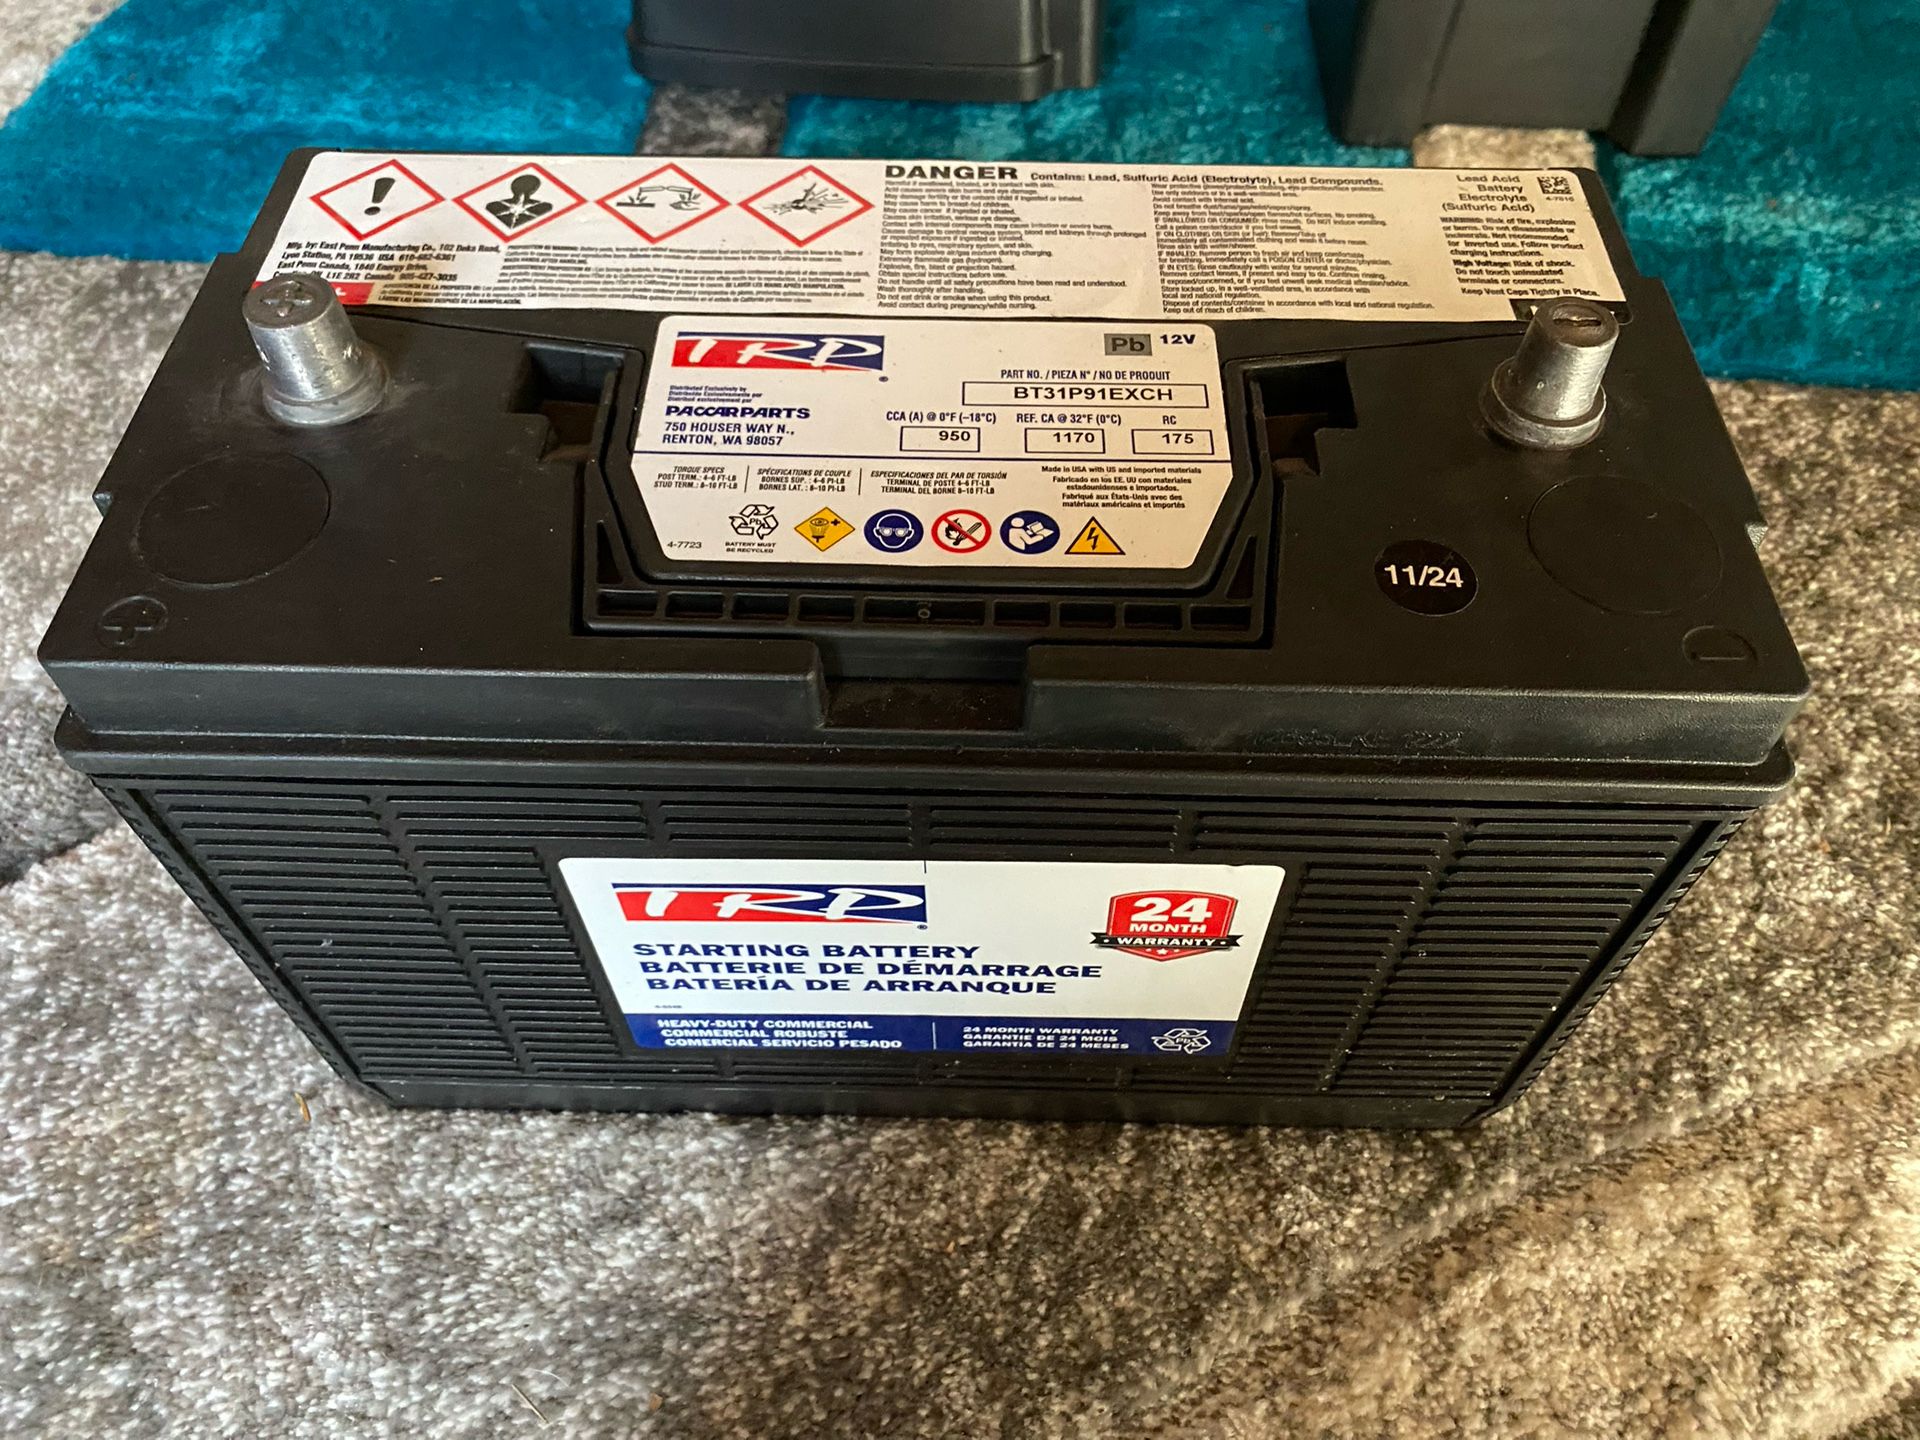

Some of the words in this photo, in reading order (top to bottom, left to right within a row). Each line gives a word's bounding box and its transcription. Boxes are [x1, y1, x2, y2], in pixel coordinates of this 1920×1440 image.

[885, 165, 1017, 180] DANGER
[1088, 173, 1119, 181] Lead,
[1171, 175, 1197, 184] Acid
[1201, 175, 1275, 184] (Electrolyte),
[1278, 176, 1306, 184] Lead
[1309, 177, 1382, 185] Compounds.
[1477, 184, 1523, 192] Battery
[1458, 193, 1527, 201] Electrolyte
[1442, 202, 1496, 211] (Sulfuric
[1501, 203, 1534, 211] Acid)
[1452, 259, 1473, 267] High
[1461, 287, 1482, 295] Keep
[1530, 288, 1560, 296] Tightly
[1572, 288, 1599, 297] Place.
[1111, 337, 1145, 352] Pb
[1160, 334, 1196, 345] 12V
[674, 333, 883, 371] TRP
[1000, 369, 1023, 378] PART
[1026, 369, 1042, 379] NO.
[1051, 369, 1077, 379] PIEZA
[1099, 370, 1112, 379] NO
[1114, 370, 1126, 379] DE
[1129, 370, 1169, 380] PRODUIT
[1014, 386, 1173, 401] BT31P91EXCH
[886, 411, 905, 421] CCA
[908, 411, 923, 423] (A)
[939, 412, 955, 421] 0°F
[1016, 413, 1037, 423] REF.
[1040, 413, 1054, 423] CA
[1070, 413, 1092, 423] 32°F
[1096, 414, 1121, 425] (0°C)
[1162, 415, 1177, 425] RC
[665, 421, 687, 431] 750
[689, 421, 742, 433] HOUSER
[744, 423, 772, 435] WAY
[661, 433, 717, 444] RENTON,
[721, 435, 742, 444] WA
[745, 435, 782, 445] 98057
[938, 430, 971, 442] 950
[1053, 432, 1095, 444] 1170
[1161, 433, 1194, 445] 175
[673, 465, 701, 474] TORQUE
[701, 466, 725, 475] SPECS
[756, 468, 812, 477] SPÉCIFICATIONS
[813, 469, 823, 477] DE
[824, 469, 851, 478] COUPLE
[869, 470, 935, 479] ESPECIFICACIONES
[950, 471, 965, 480] PAR
[965, 472, 975, 480] DE
[976, 472, 1007, 480] TORSIÓN
[1100, 476, 1112, 484] los
[1061, 493, 1093, 501] Fabriqué
[1110, 493, 1148, 501] États-Unis
[667, 541, 702, 550] 4-7723
[1384, 564, 1464, 588] 11/24
[614, 885, 925, 922] TRP
[1130, 896, 1212, 923] 24
[1129, 923, 1207, 934] MONTH
[1116, 937, 1216, 947] WARRANTY
[634, 943, 809, 956] STARTING
[823, 945, 978, 958] BATTERY
[641, 961, 804, 974] BATTERIE
[818, 962, 864, 975] DE
[877, 960, 1103, 978] DÉMARRAGE
[647, 975, 793, 991] BATERÍA
[805, 979, 850, 992] DE
[863, 980, 1057, 995] ARRANQUE
[657, 1019, 757, 1029] HEAVY-DUTY
[763, 1020, 872, 1030] COMMERCIAL
[661, 1029, 769, 1039] COMMERCIAL
[773, 1029, 847, 1039] ROBUSTE
[963, 1026, 980, 1034] 24
[984, 1027, 1035, 1035] MONTH
[1039, 1028, 1118, 1036] WARRANTY
[664, 1038, 757, 1046] COMERCIAL
[761, 1039, 834, 1047] SERVICIO
[838, 1039, 902, 1047] PESADO
[963, 1034, 1031, 1042] GARANTIE
[1059, 1035, 1076, 1043] 24
[1081, 1035, 1117, 1043] MOIS
